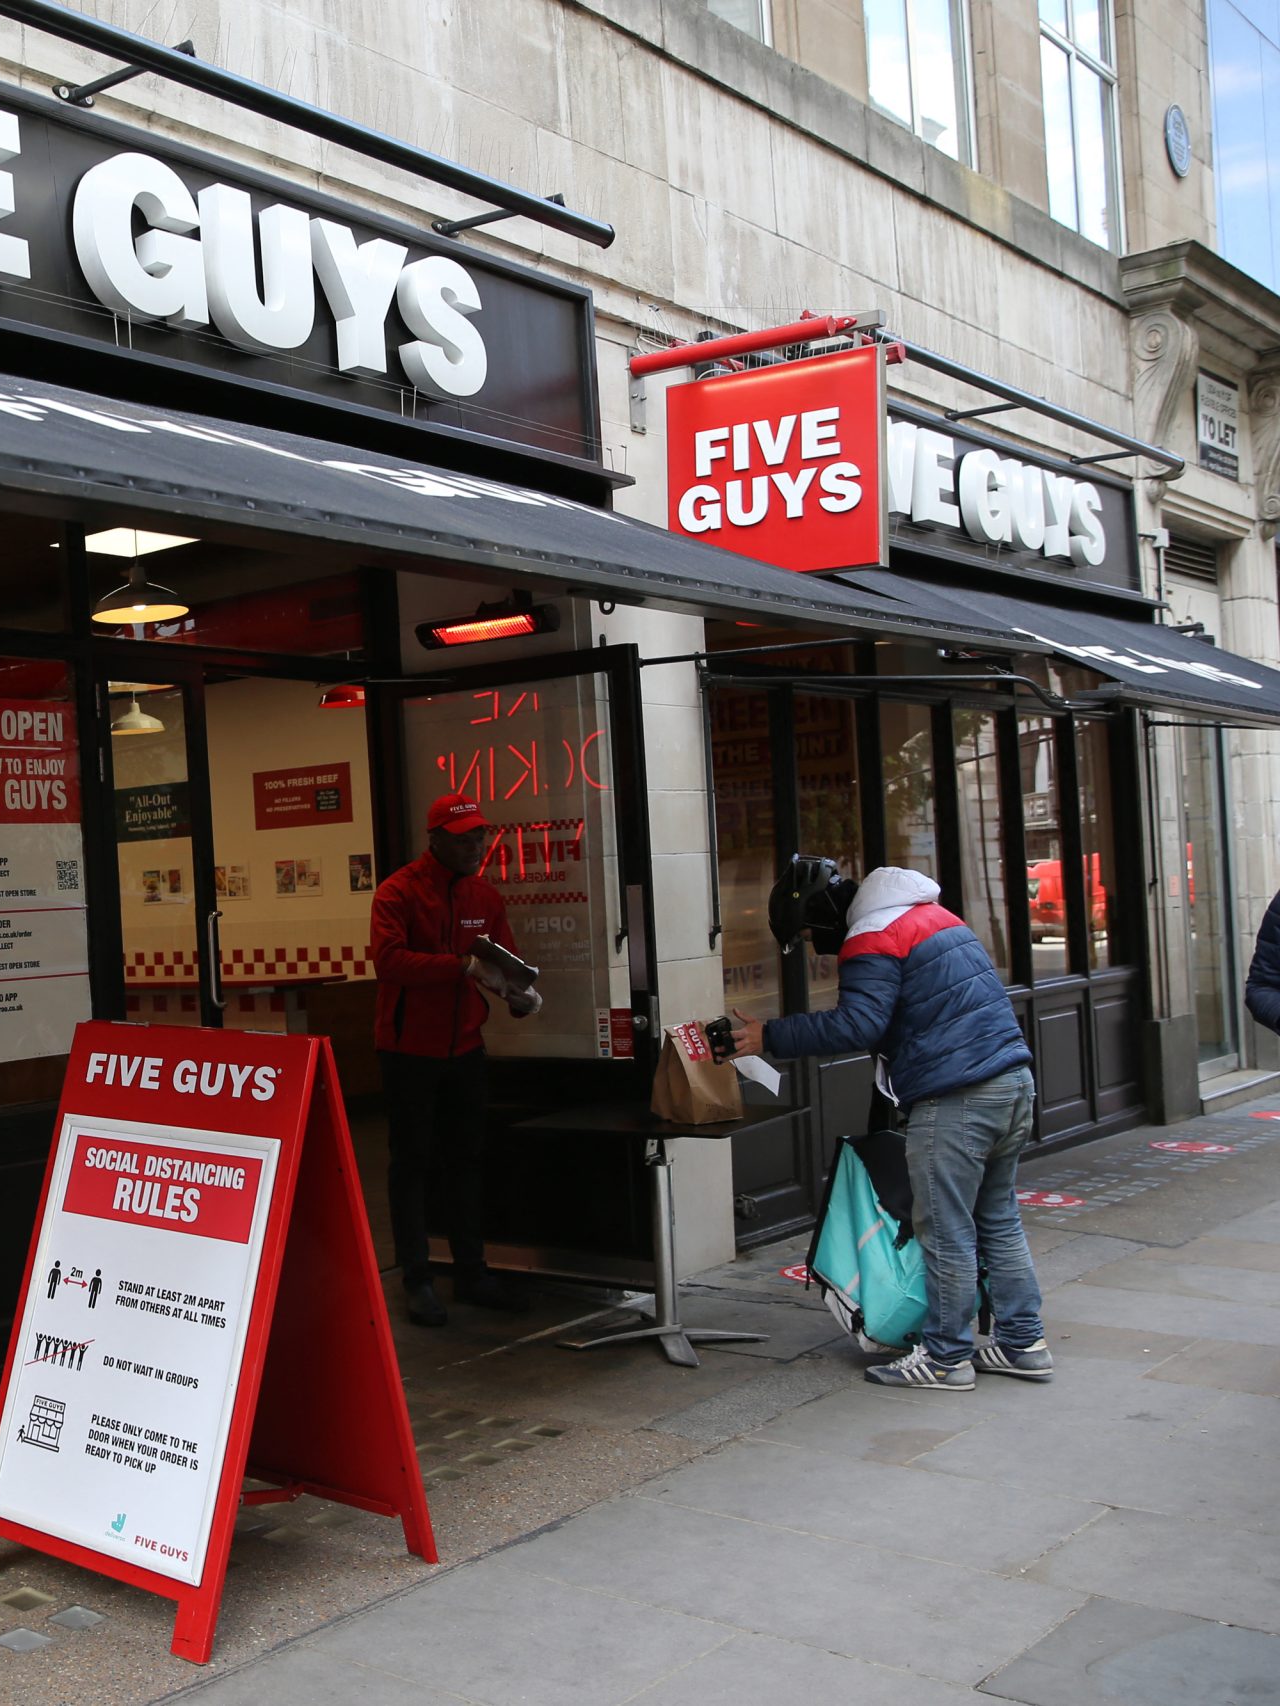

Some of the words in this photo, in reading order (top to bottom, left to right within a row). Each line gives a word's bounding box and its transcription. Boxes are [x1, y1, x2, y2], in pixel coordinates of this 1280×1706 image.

[72, 151, 488, 397] GUYS
[695, 406, 842, 478] FIVE
[1201, 413, 1216, 440] TO
[1218, 421, 1236, 449] LET
[677, 461, 862, 534] GUYS
[886, 415, 961, 528] VE
[958, 447, 1107, 567] GUYS
[0, 709, 64, 742] OPEN
[5, 758, 22, 775] TO
[26, 758, 65, 776] ENJOY
[264, 779, 286, 791] 100%
[287, 777, 315, 788] FRESH
[316, 773, 339, 784] BEEF
[4, 779, 68, 810] GUYS
[5, 889, 19, 897] OPEN
[20, 889, 37, 897] STORE
[8, 962, 23, 970] OPEN
[24, 961, 40, 969] STORE
[5, 992, 18, 1002] APP
[688, 1027, 706, 1055] GUYS
[84, 1052, 164, 1091] FIVE
[172, 1058, 277, 1102] GUYS
[84, 1146, 140, 1176] SOCIAL
[143, 1154, 246, 1191] DISTANCING
[112, 1176, 201, 1223] RULES
[70, 1266, 84, 1279] 2m
[115, 1294, 139, 1310] FROM
[139, 1298, 171, 1317] OTHERS
[172, 1304, 183, 1319] AT
[183, 1307, 199, 1324] ALL
[201, 1311, 227, 1329] TIMES
[118, 1279, 144, 1296] STAND
[145, 1283, 156, 1297] AT
[156, 1286, 182, 1303] LEAST
[184, 1293, 197, 1306] 2M
[198, 1296, 226, 1313] APART
[103, 1355, 114, 1368] DO
[115, 1357, 132, 1372] NOT
[133, 1361, 154, 1378] WAIT
[154, 1366, 164, 1380] IN
[165, 1369, 199, 1389] GROUPS
[35, 1397, 48, 1407] FIVE
[48, 1401, 64, 1412] GUYS
[88, 1429, 110, 1446] DOOR
[111, 1434, 136, 1453] WHEN
[136, 1441, 158, 1459] YOUR
[160, 1448, 188, 1468] ORDER
[190, 1457, 199, 1471] IS
[91, 1413, 121, 1431] PLEASE
[122, 1420, 143, 1438] ONLY
[144, 1426, 168, 1445] COME
[170, 1434, 180, 1449] TO
[181, 1437, 198, 1454] THE
[85, 1443, 112, 1462] READY
[112, 1450, 123, 1465] TO
[124, 1454, 144, 1470] PICK
[144, 1461, 157, 1474] UP
[134, 1535, 158, 1551] FIVE
[160, 1542, 189, 1562] GUYS
